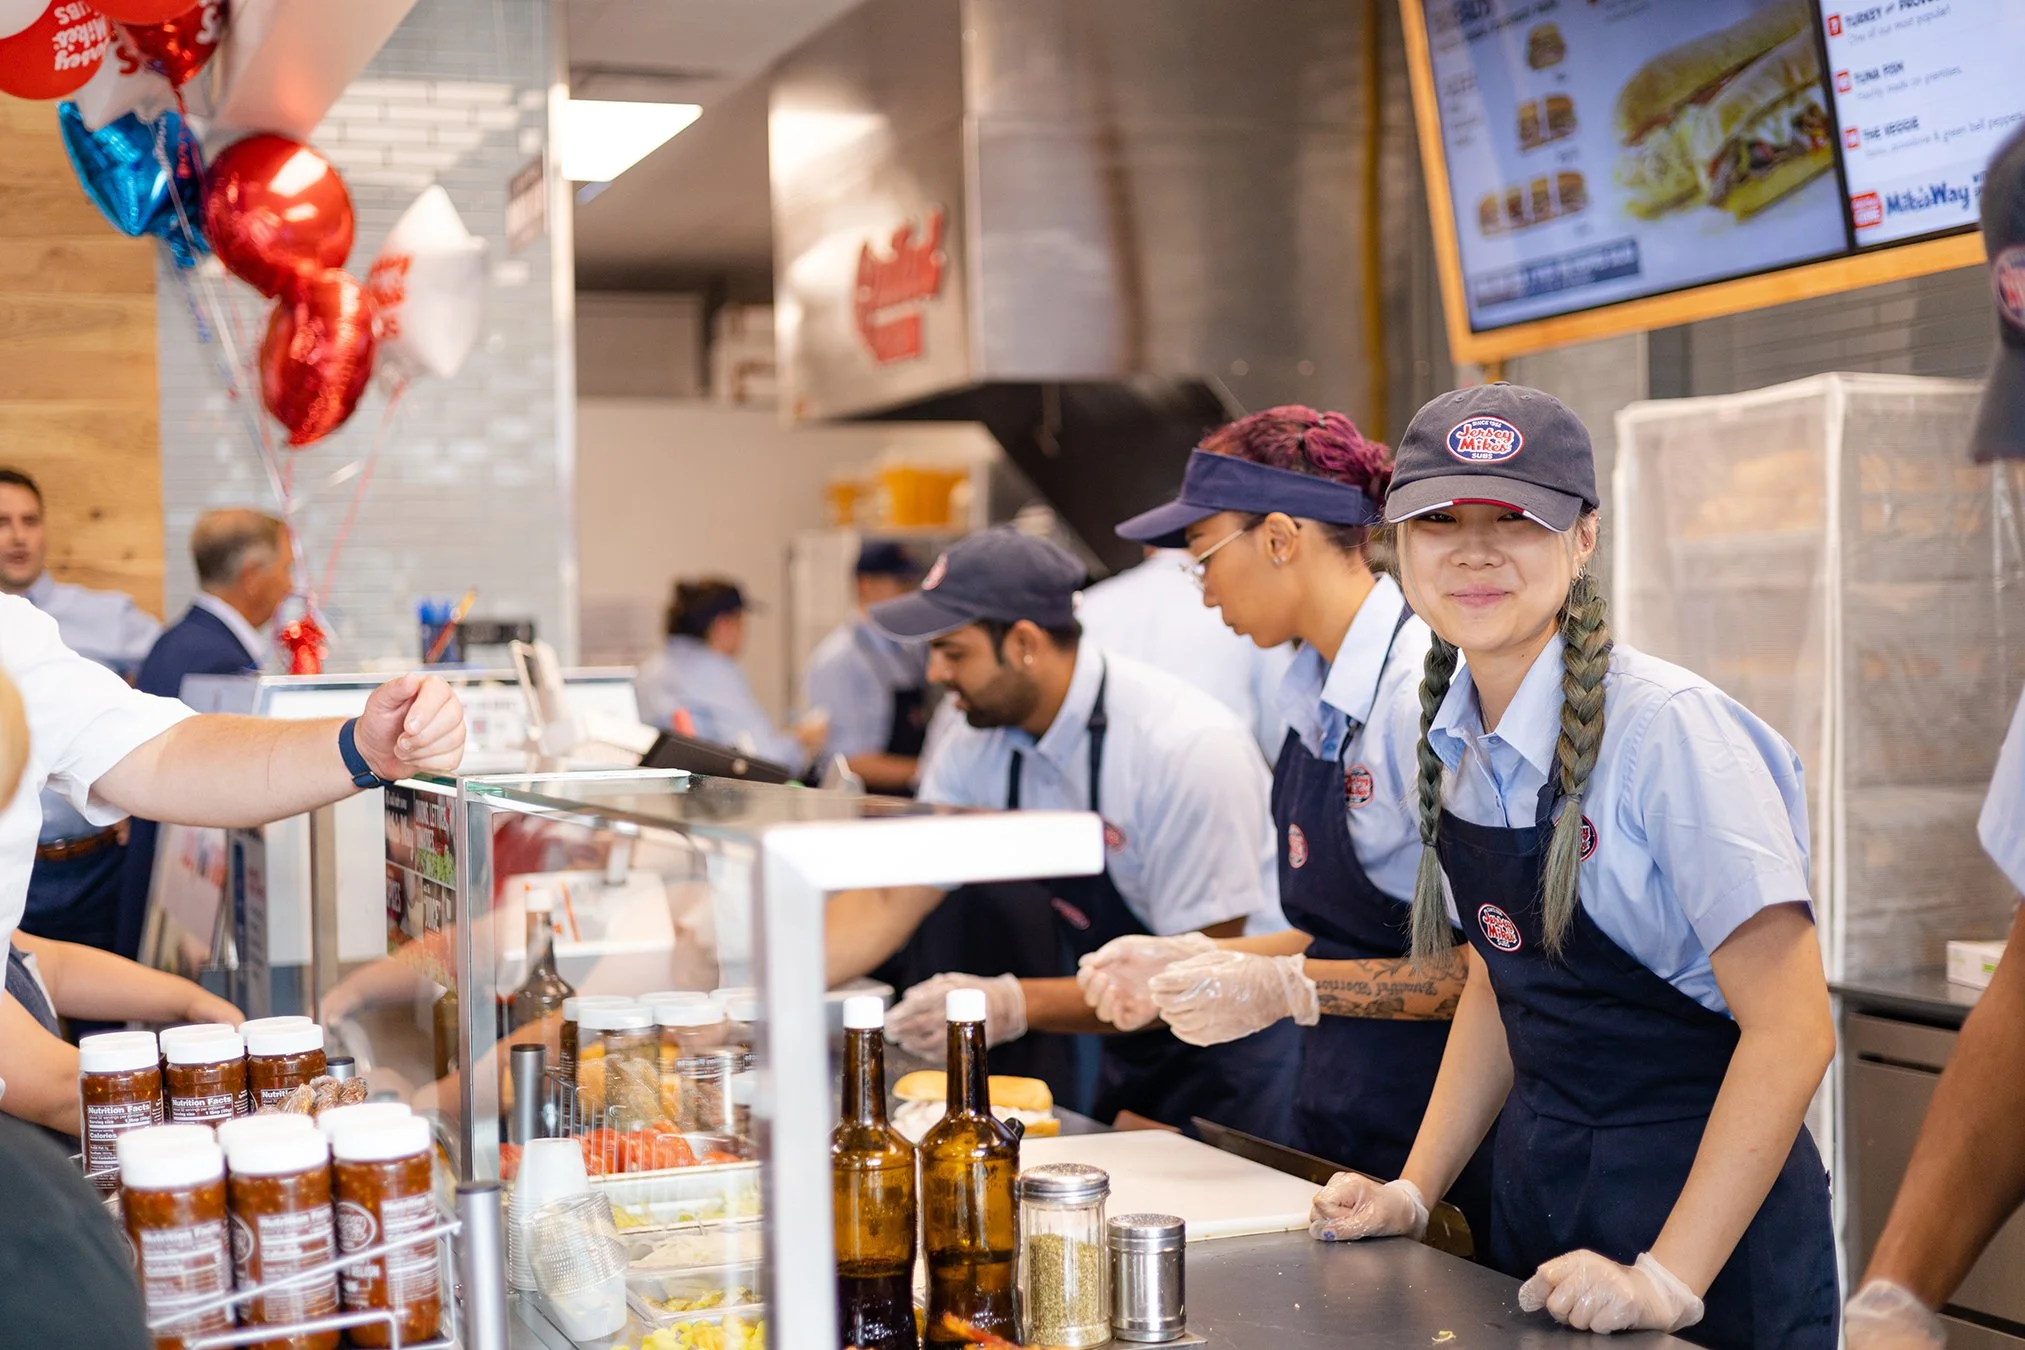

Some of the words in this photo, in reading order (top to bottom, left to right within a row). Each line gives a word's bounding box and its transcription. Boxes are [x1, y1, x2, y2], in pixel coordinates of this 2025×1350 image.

[1845, 7, 1882, 27] TURKEY
[1885, 116, 1920, 136] VEGGIE
[1457, 424, 1514, 442] Jersey
[1482, 909, 1514, 934] Jersey
[172, 1098, 206, 1107] Nutrition
[207, 1096, 232, 1105] Facts
[262, 1088, 292, 1098] Nutriti
[88, 1106, 125, 1115] Nutrition
[127, 1103, 150, 1113] Facts
